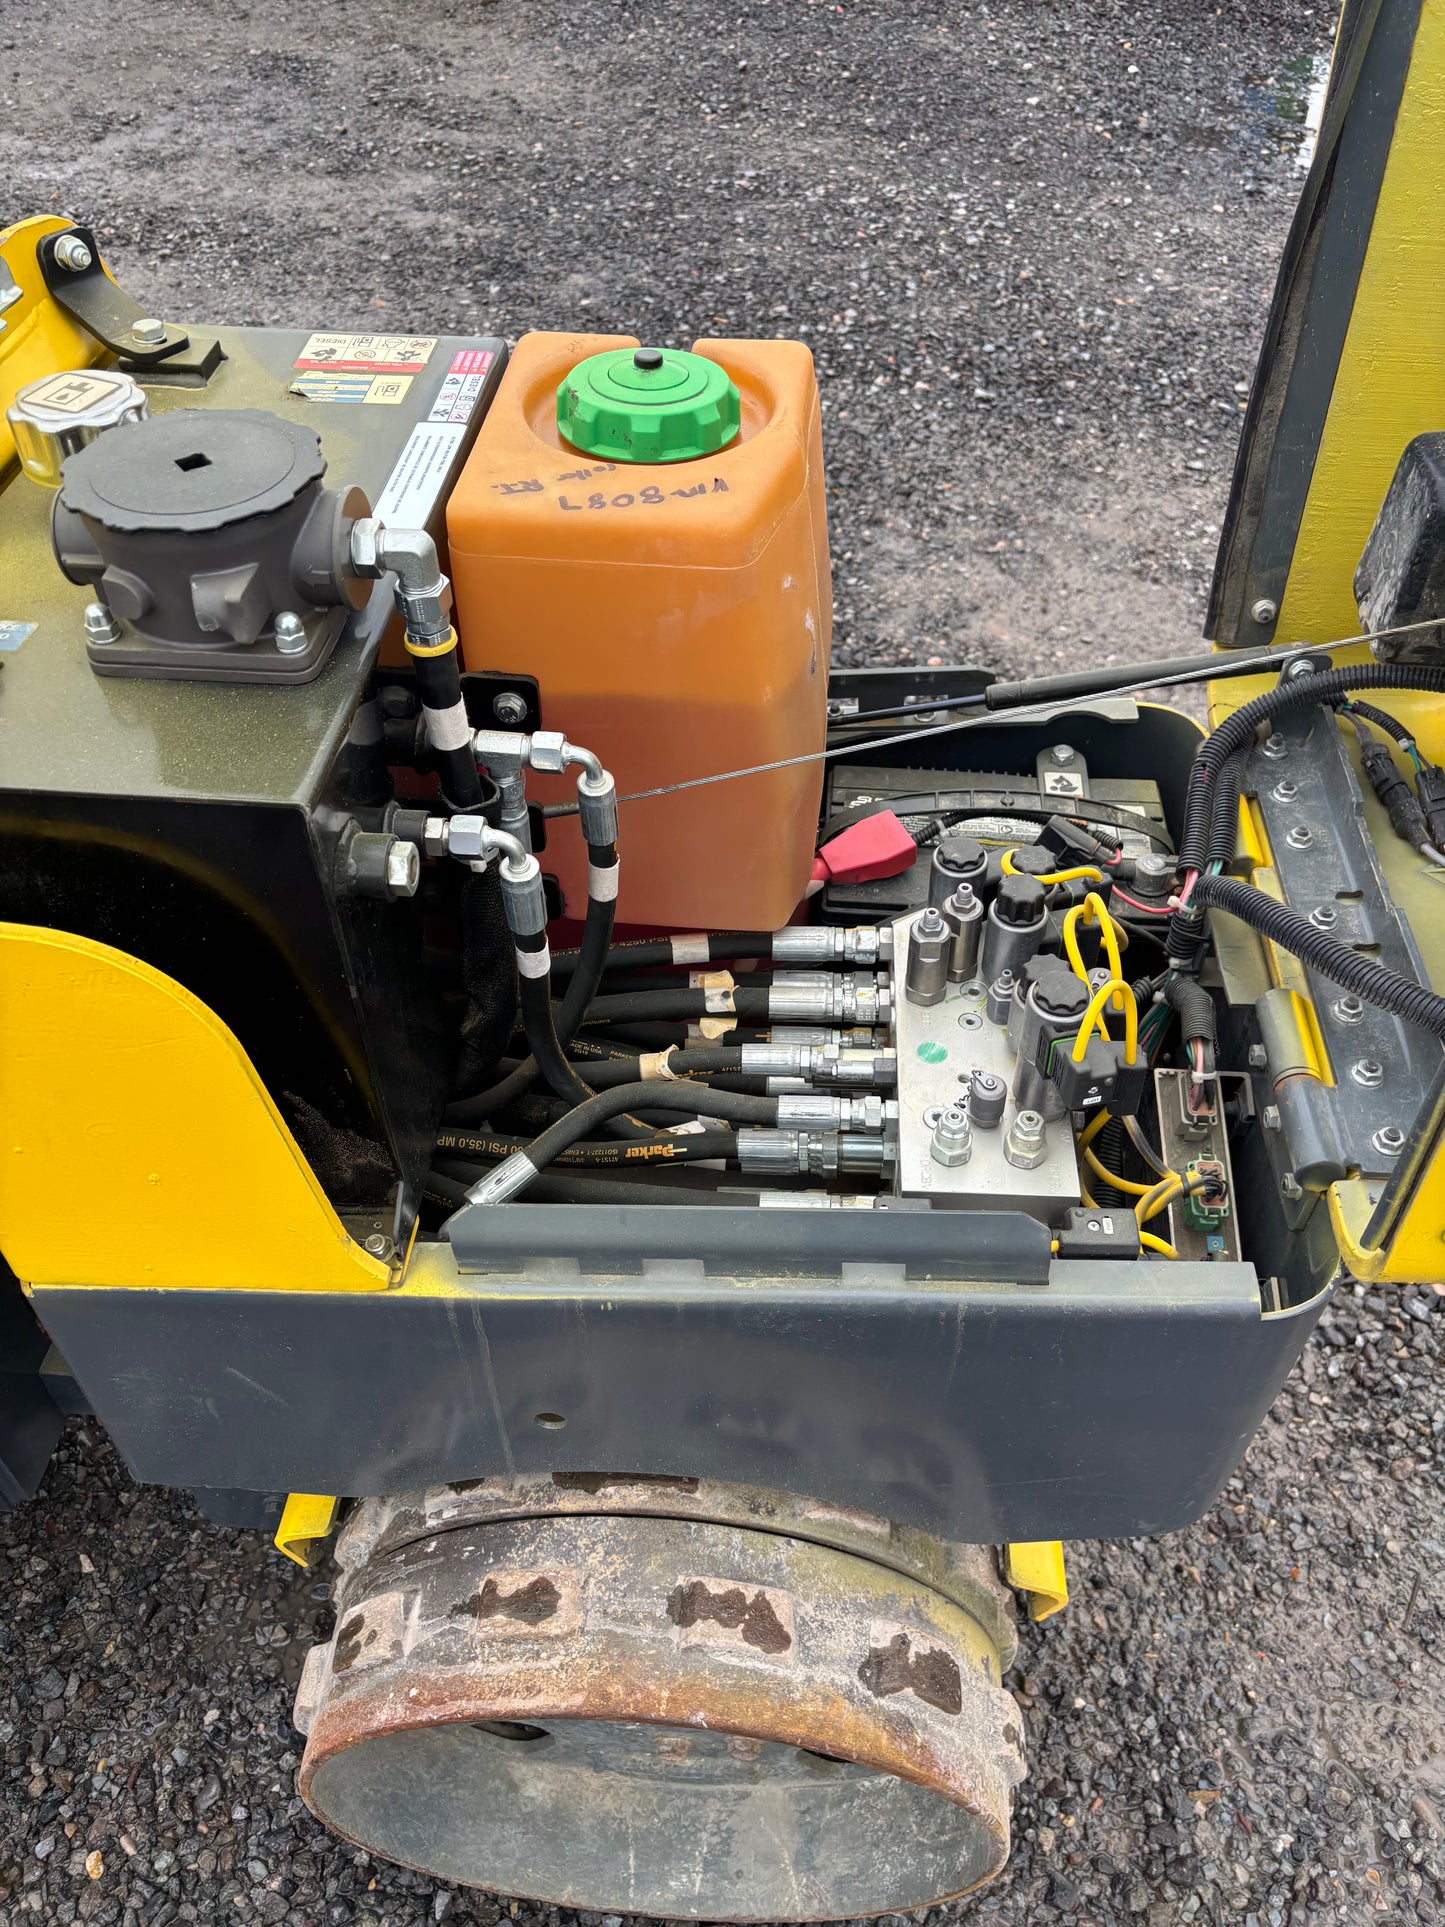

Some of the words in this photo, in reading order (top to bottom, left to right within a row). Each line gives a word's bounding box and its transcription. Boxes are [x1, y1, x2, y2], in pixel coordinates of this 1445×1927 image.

[314, 337, 347, 345] DIESEL
[488, 1141, 508, 1155] PSI
[624, 1143, 674, 1160] Parker
